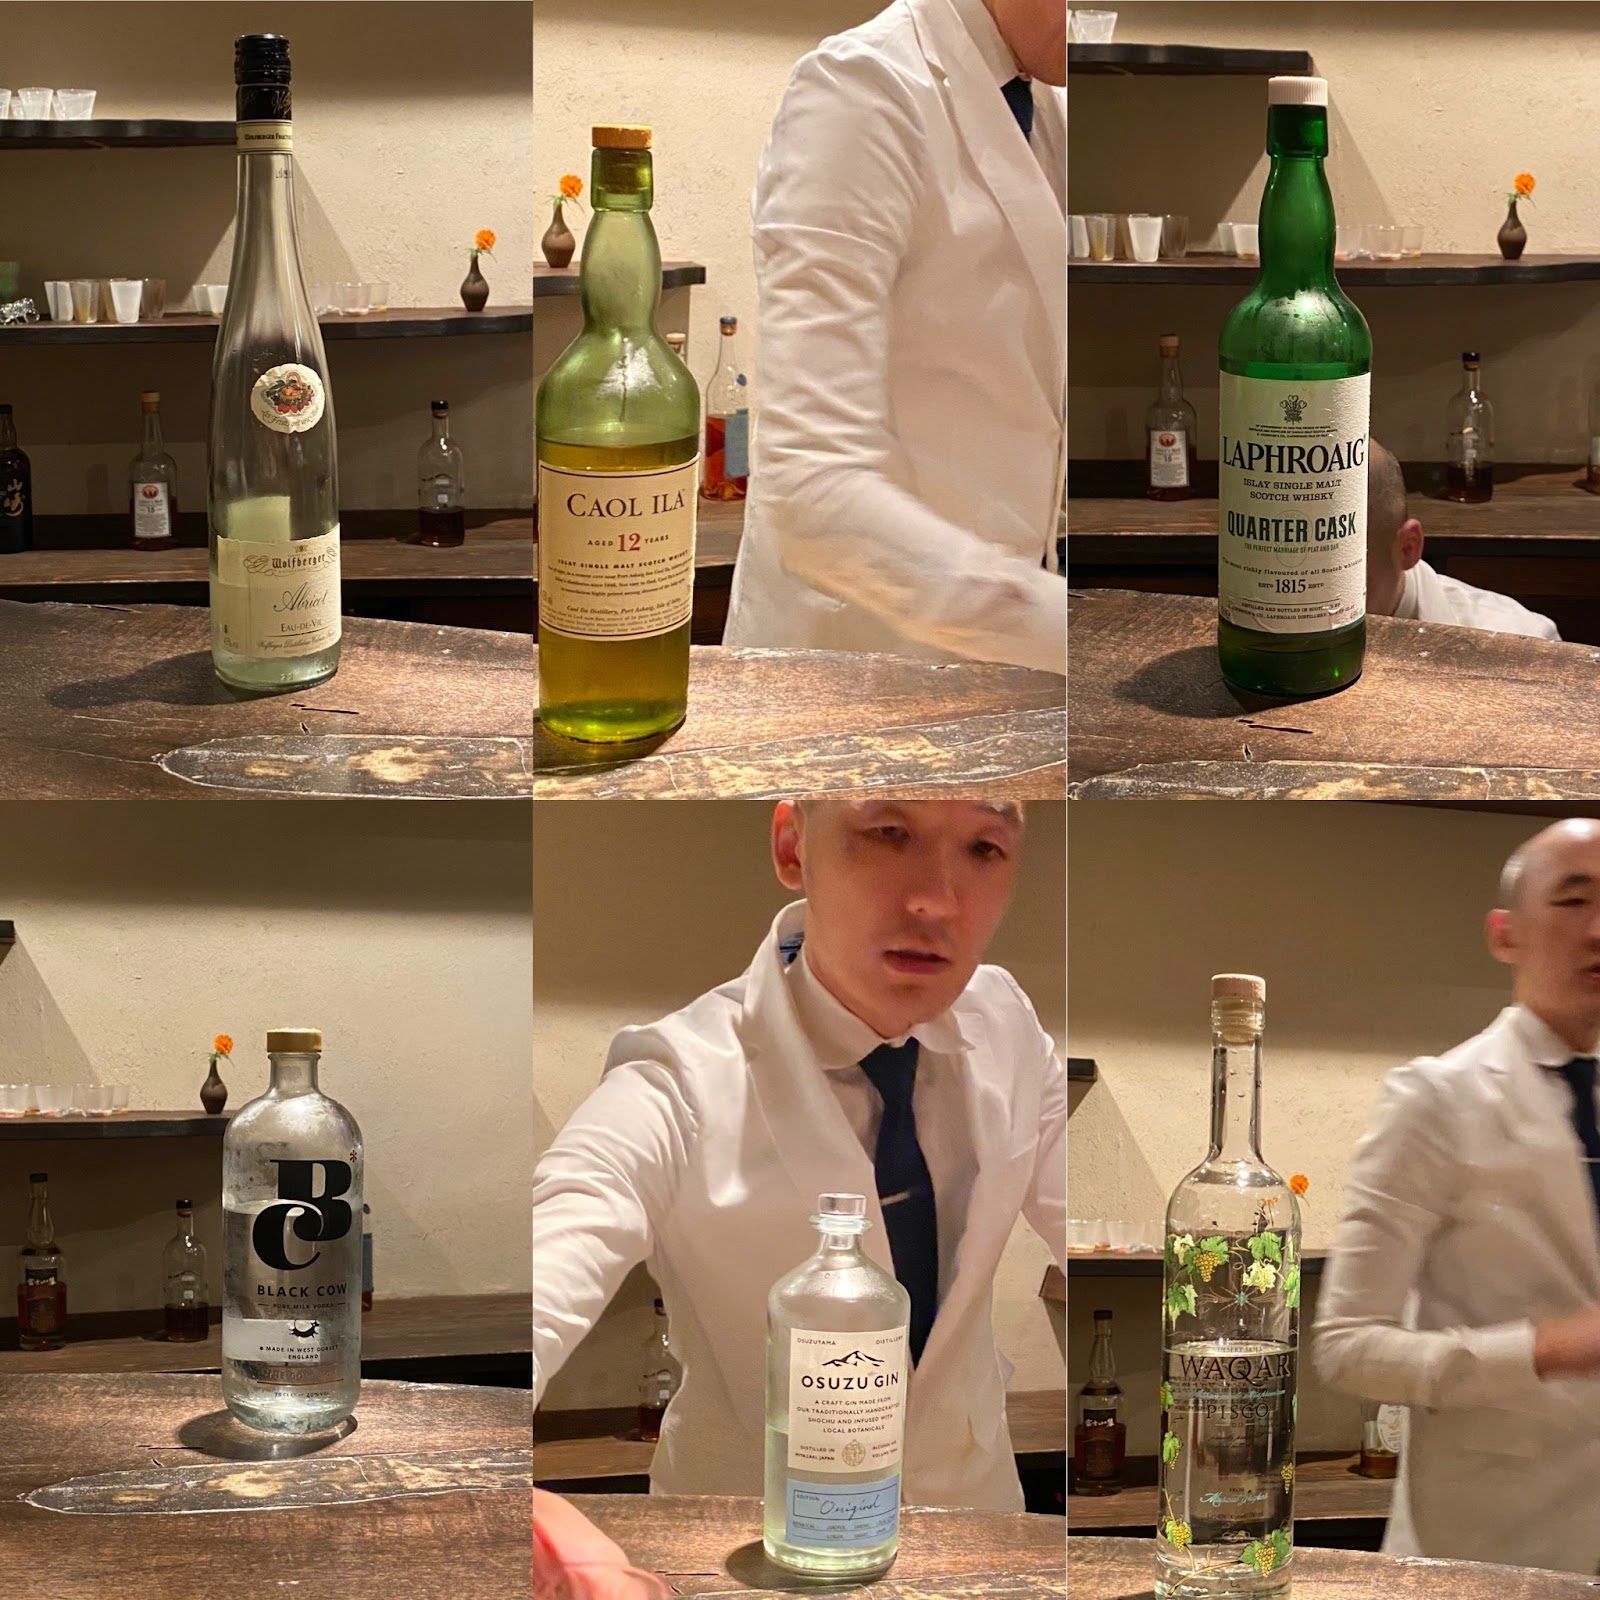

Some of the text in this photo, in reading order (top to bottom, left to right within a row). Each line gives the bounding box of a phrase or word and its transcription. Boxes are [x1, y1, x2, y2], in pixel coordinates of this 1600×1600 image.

[1222, 436, 1364, 474] LAPHROAIG
[1243, 477, 1342, 490] ISLAY SINGLE MALT
[566, 489, 686, 518] CAOL ILA
[1250, 491, 1334, 502] SCOTCH WHISKY
[1228, 510, 1356, 543] QUARTER CASK
[588, 532, 670, 552] AGED 12 YEARS
[1253, 543, 1273, 553] PERFECT
[272, 553, 326, 569] Wolfberger
[638, 558, 666, 568] SCOTCH
[1243, 564, 1262, 576] richly
[1264, 568, 1299, 576] flavoured
[1310, 568, 1320, 576] all
[1275, 579, 1307, 594] 1815
[273, 581, 328, 612] Abricot
[257, 1282, 347, 1298] BLACK COW
[316, 1344, 338, 1352] DORSET
[1180, 1354, 1291, 1388] WAQAR
[801, 1371, 899, 1390] OSUZU GIN
[1206, 1402, 1269, 1420] PISCO
[854, 1416, 879, 1424] INFUSED
[847, 1424, 885, 1434] BOTANICALS
